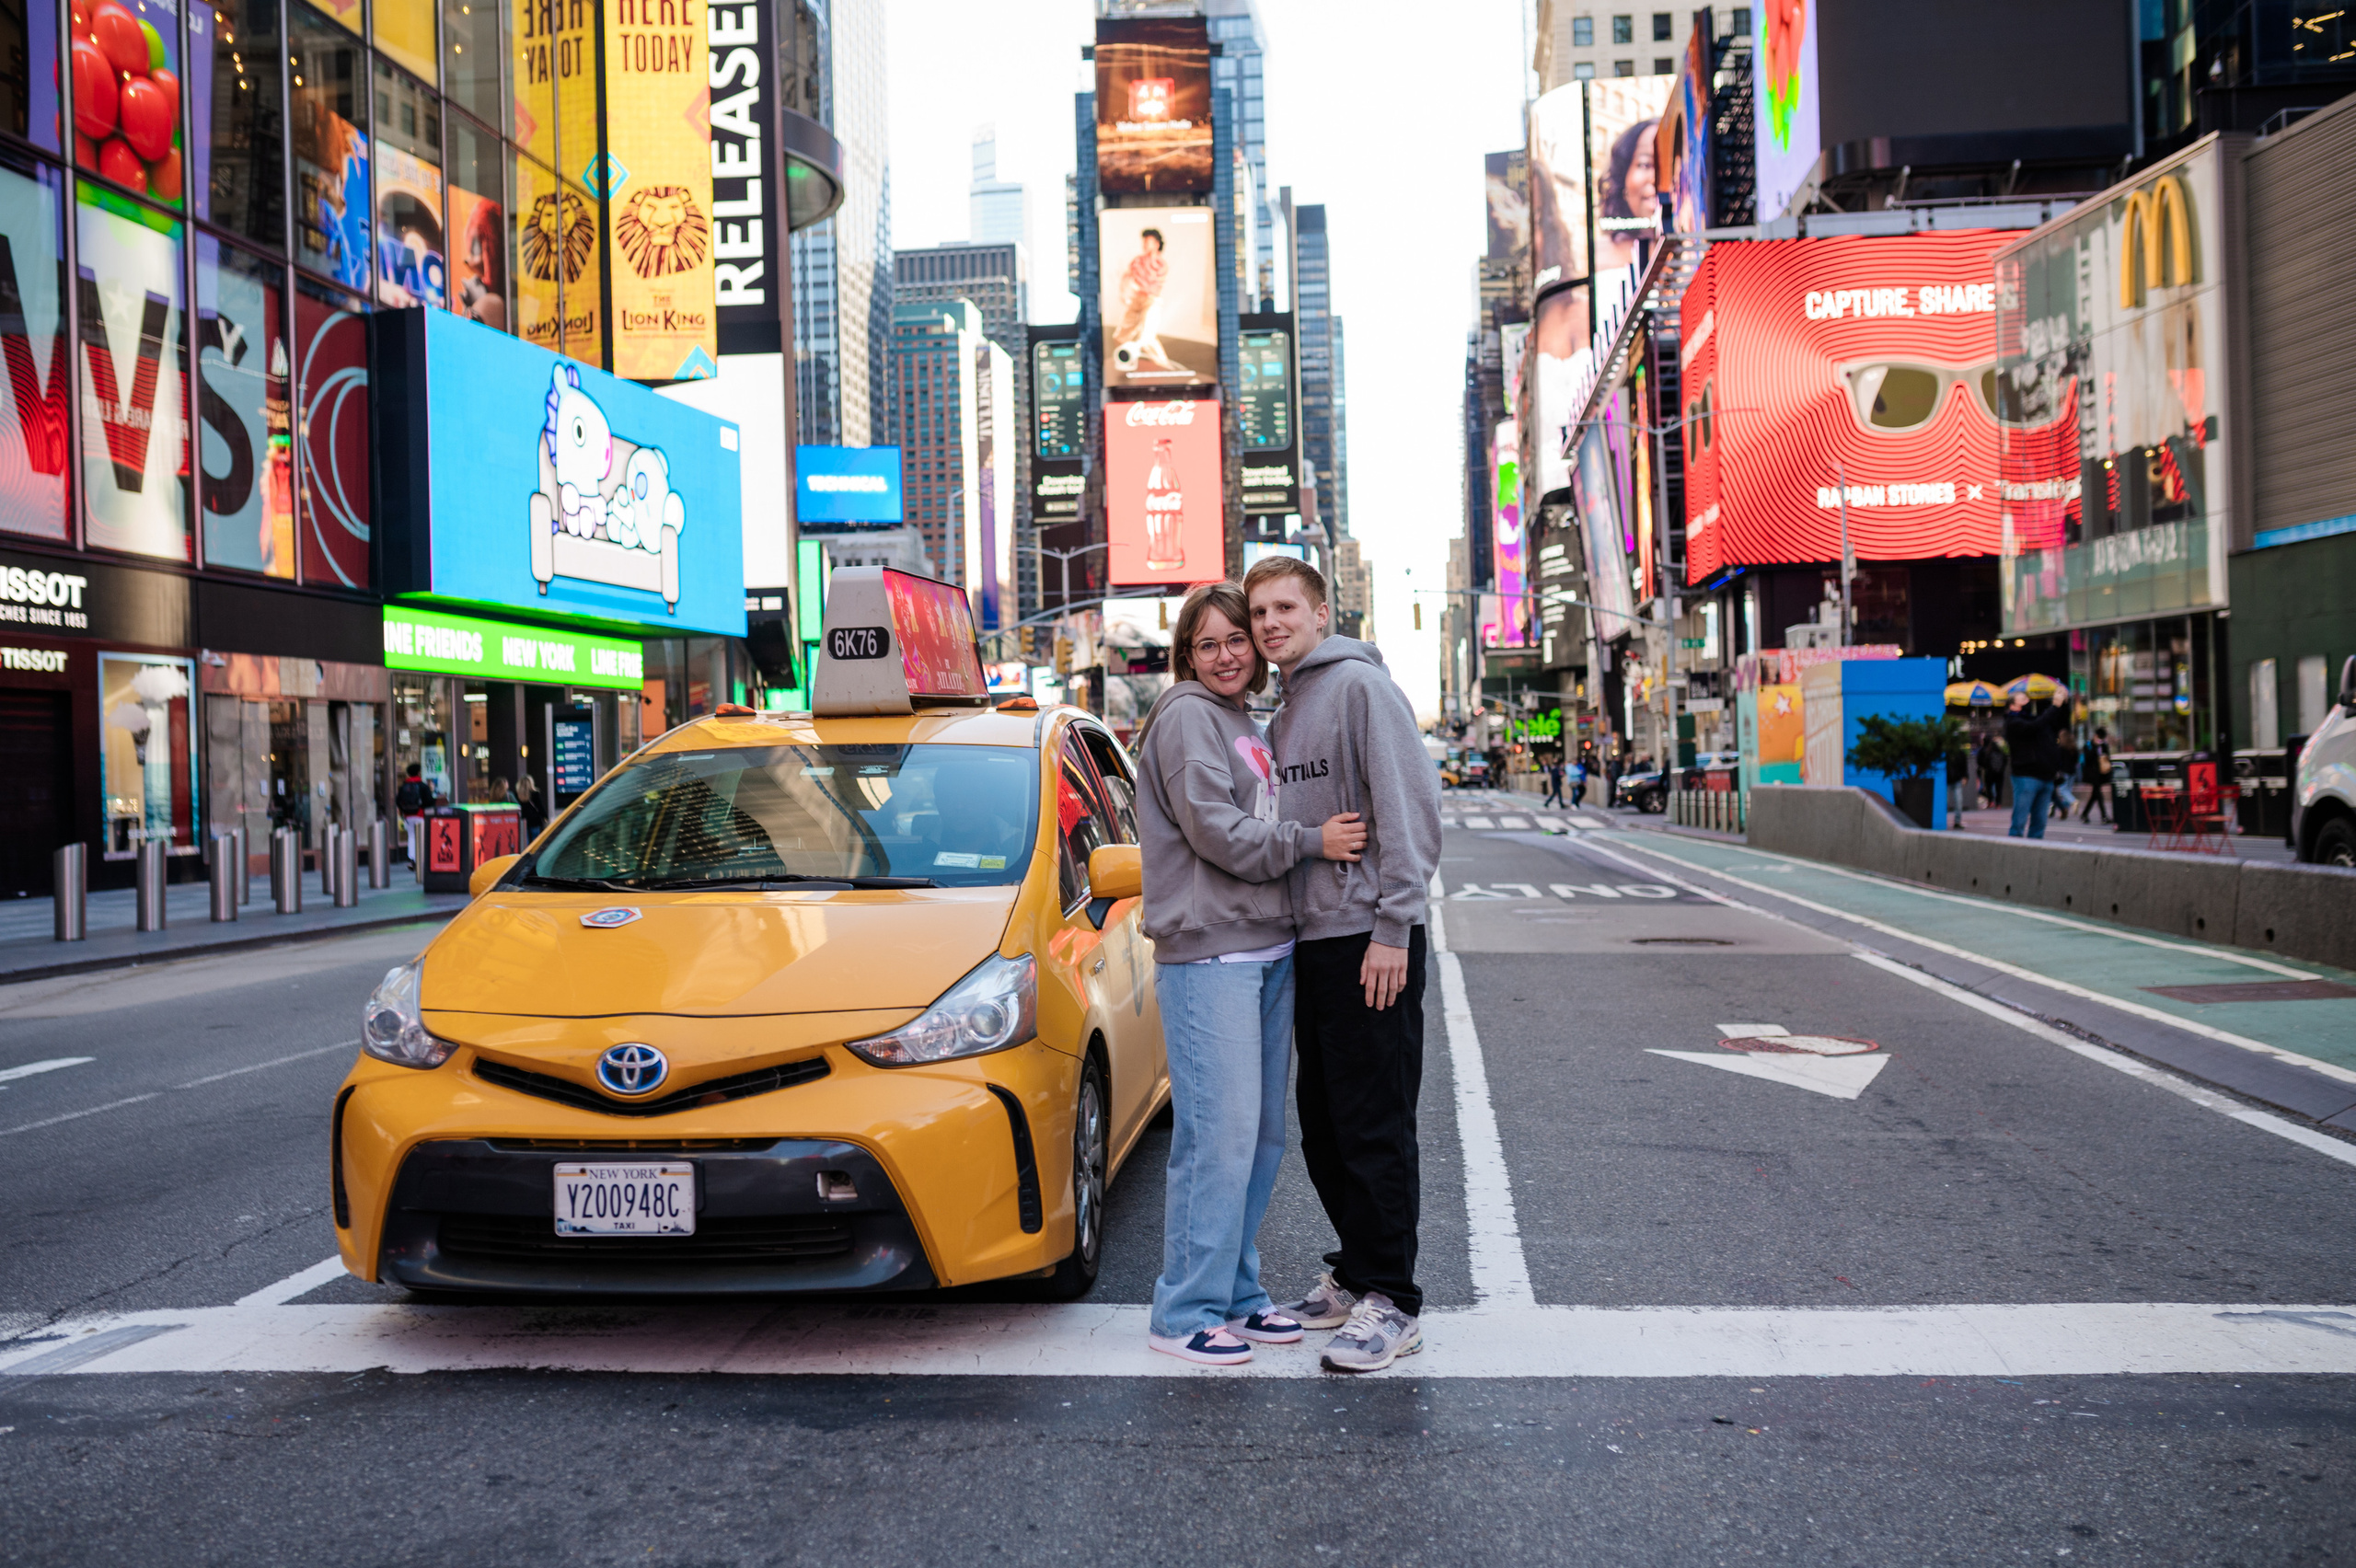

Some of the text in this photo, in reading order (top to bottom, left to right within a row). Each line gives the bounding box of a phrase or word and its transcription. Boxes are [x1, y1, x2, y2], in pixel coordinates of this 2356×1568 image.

[620, 34, 693, 73] TODAY
[708, 0, 765, 306] RELEASE
[1805, 287, 1915, 320] CAPTURE,
[1919, 282, 1996, 315] SHARE
[622, 310, 706, 330] LION KING
[1886, 481, 1957, 507] STORIES
[0, 564, 88, 609] ISSOT
[0, 604, 88, 629] CHES SINCE 1853
[384, 620, 643, 679] INE FRIENDS NEW YORK LINE FRIE
[835, 628, 878, 658] 6K76
[1, 647, 69, 674] TISSOT
[1280, 758, 1329, 786] NTIALS
[1449, 882, 1678, 901] ONLY
[589, 1169, 658, 1180] NEW YORK
[567, 1182, 680, 1218] Y200948C
[613, 1222, 635, 1230] TAXI
